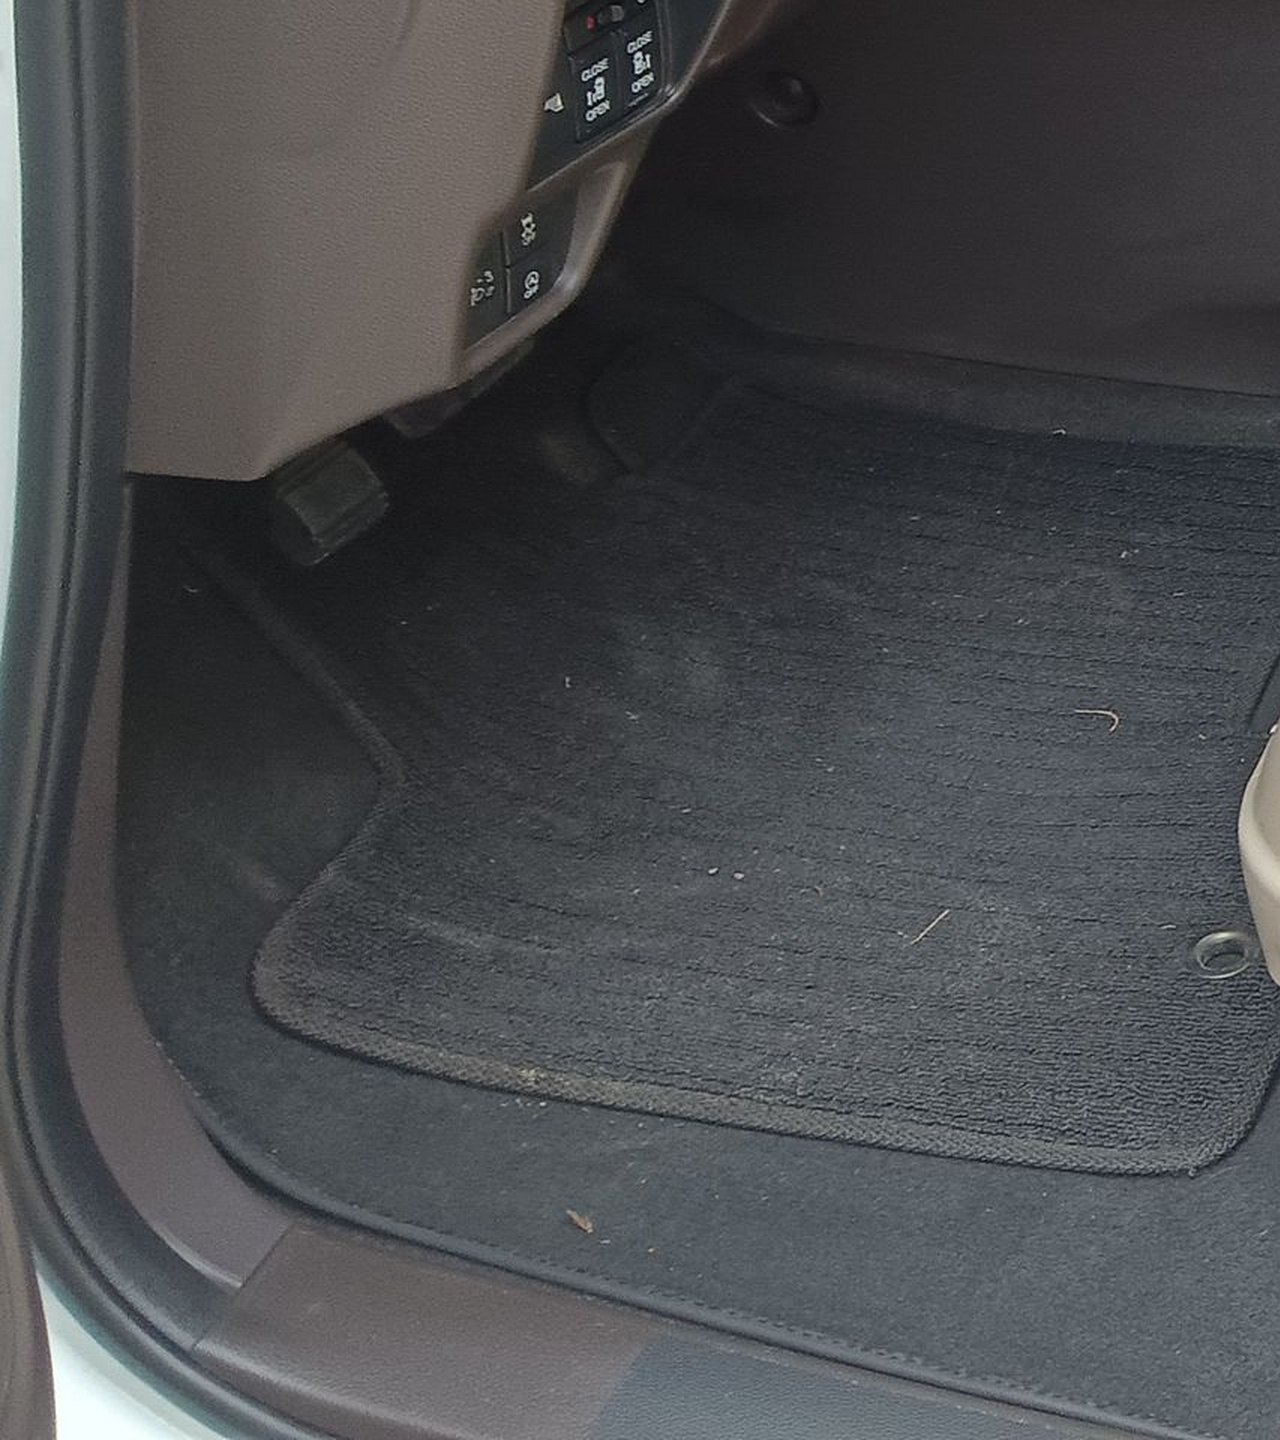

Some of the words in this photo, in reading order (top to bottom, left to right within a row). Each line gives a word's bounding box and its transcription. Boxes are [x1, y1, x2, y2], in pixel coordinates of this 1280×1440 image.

[626, 30, 653, 54] CLOSE
[580, 57, 609, 82] CLOSE
[631, 71, 655, 94] OPEN
[585, 99, 610, 122] OPEN
